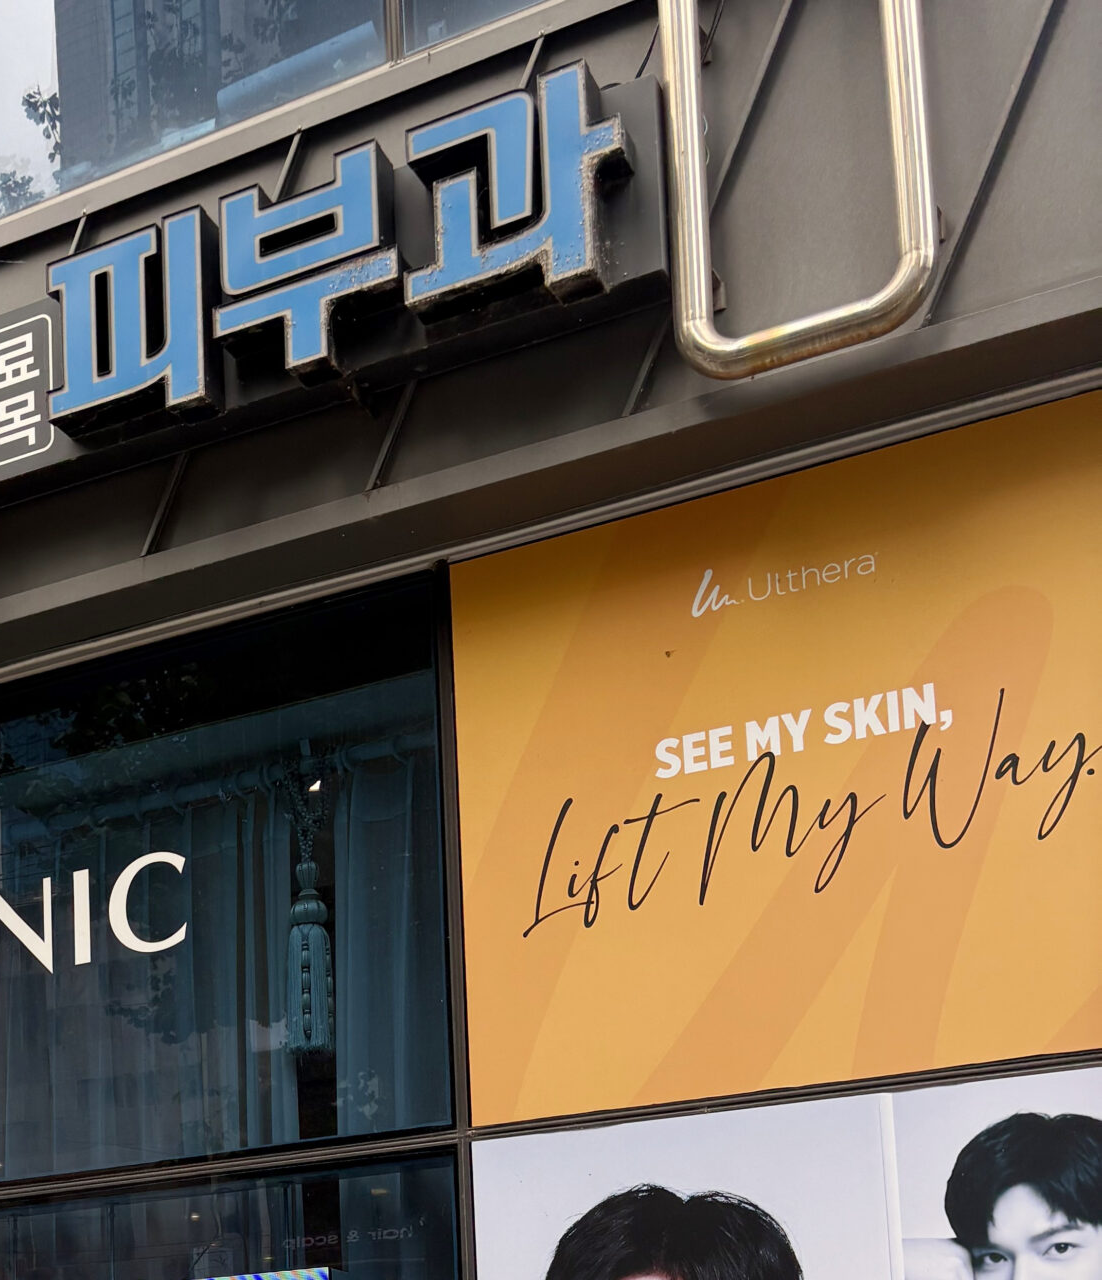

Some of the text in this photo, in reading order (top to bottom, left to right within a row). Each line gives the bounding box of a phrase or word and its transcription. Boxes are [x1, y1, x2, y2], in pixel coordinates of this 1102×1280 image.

[47, 59, 628, 416] 피부과
[747, 552, 878, 602] Ulthera
[655, 682, 953, 779] SEE MY SKIN,
[522, 794, 700, 938] Lift
[698, 751, 887, 906] My
